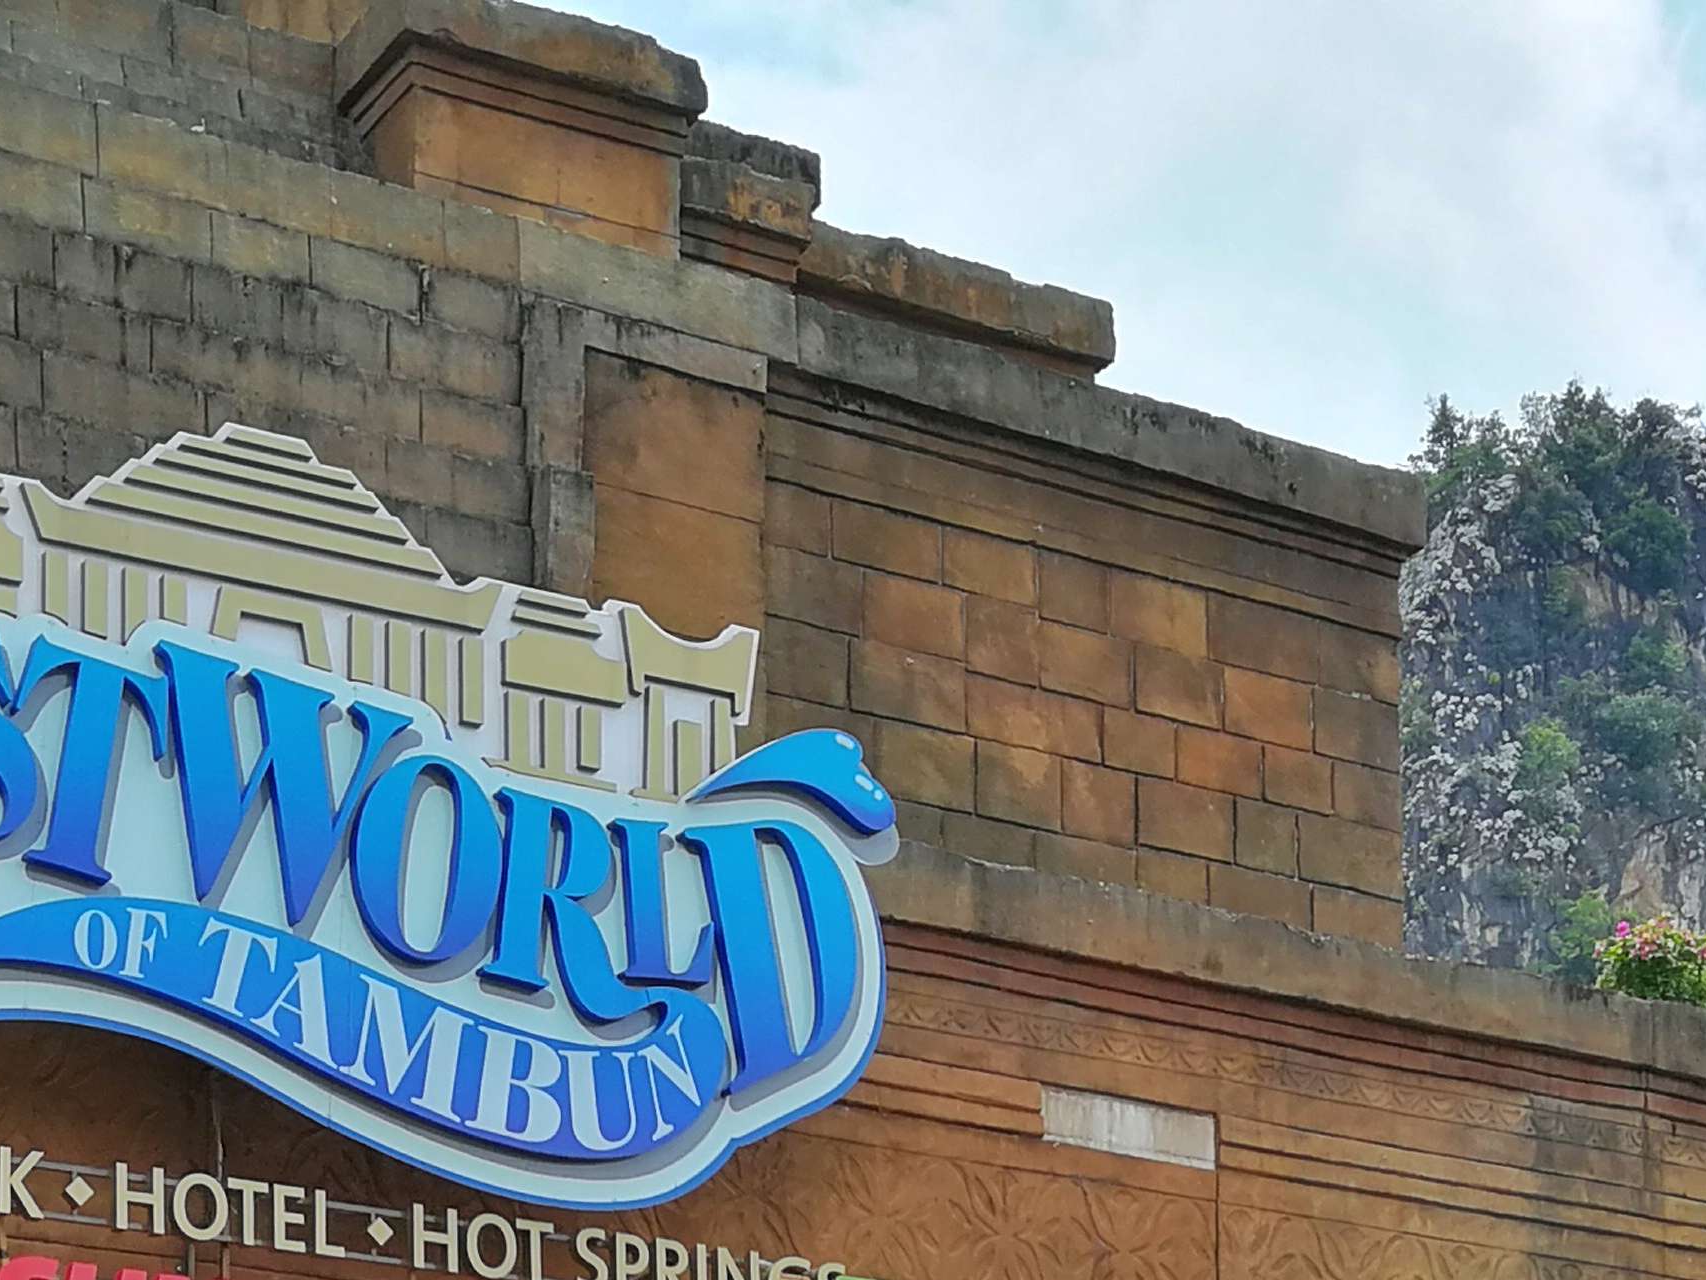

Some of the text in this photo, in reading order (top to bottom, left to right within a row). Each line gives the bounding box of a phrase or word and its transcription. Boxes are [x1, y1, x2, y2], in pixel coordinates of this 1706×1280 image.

[153, 639, 858, 1097] WORLD
[72, 907, 704, 1152] OF TAMBUN
[114, 1162, 346, 1258] HOTEL
